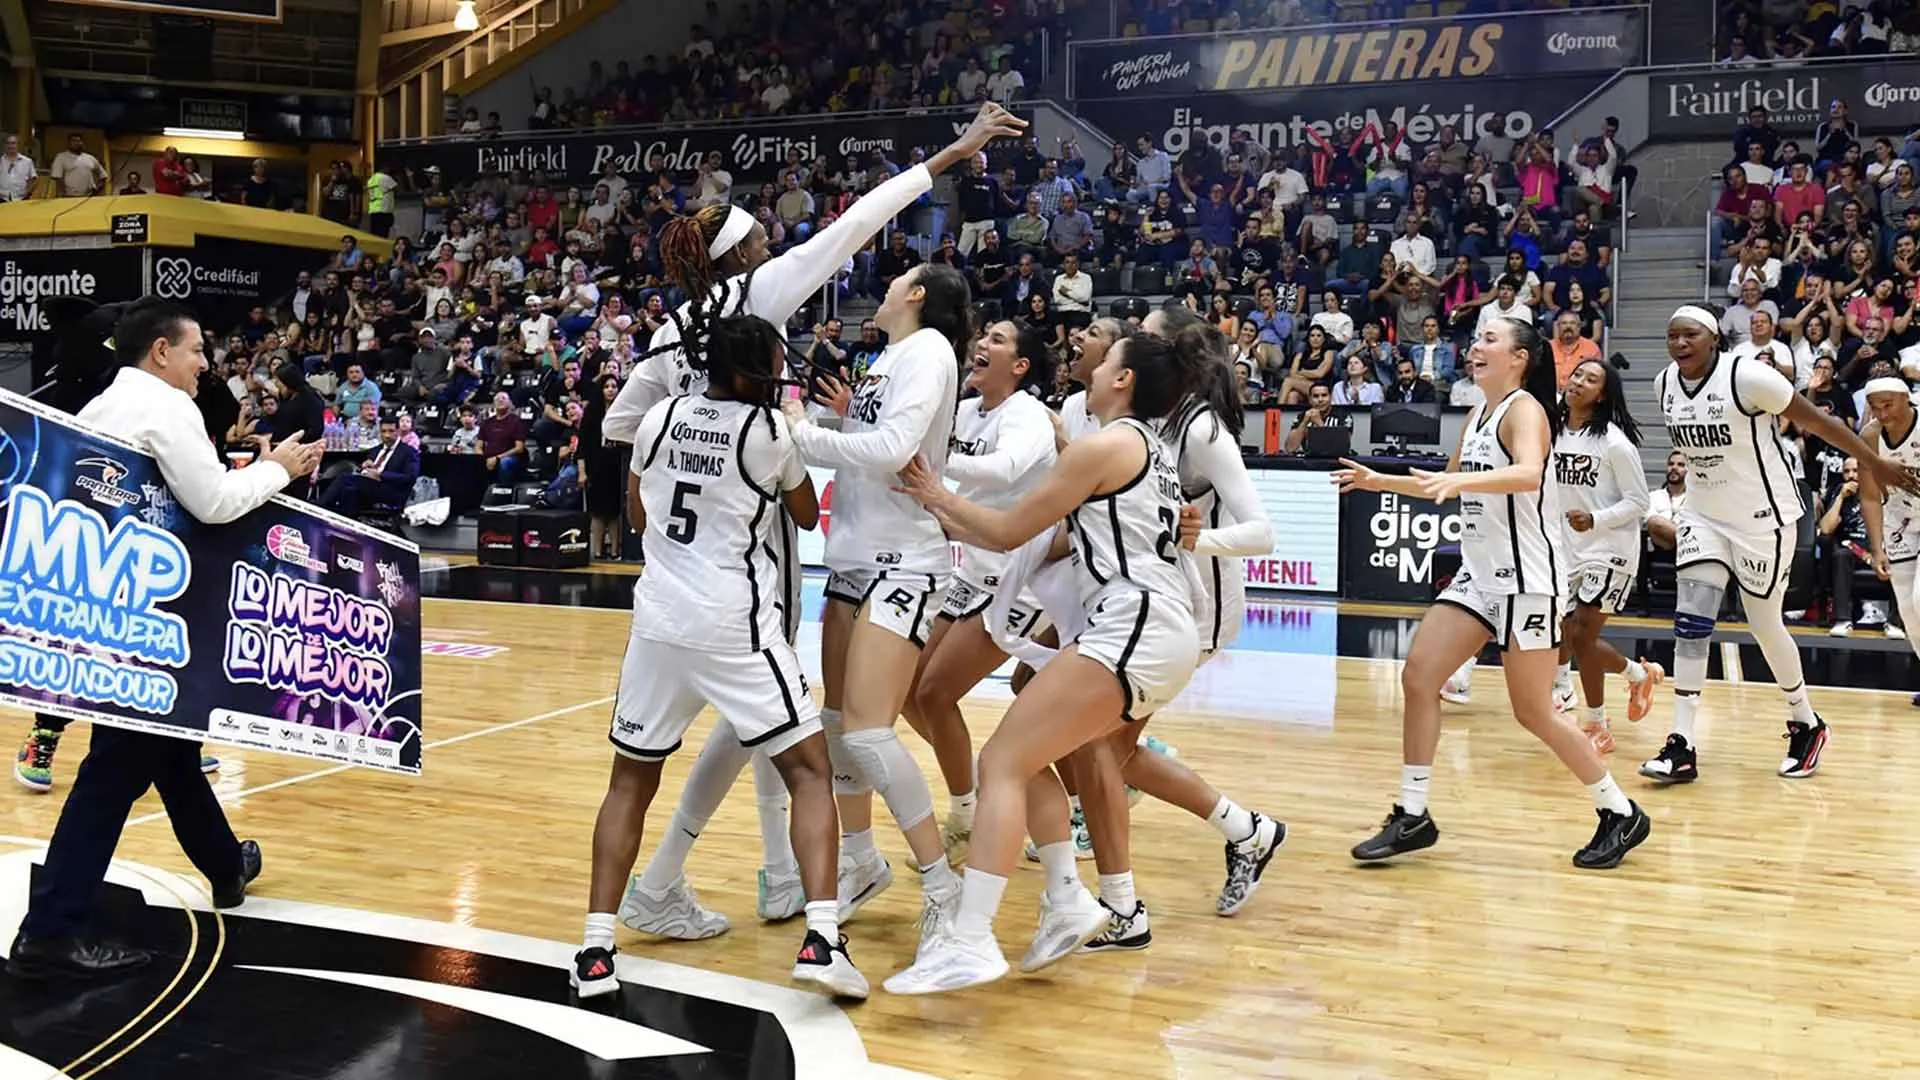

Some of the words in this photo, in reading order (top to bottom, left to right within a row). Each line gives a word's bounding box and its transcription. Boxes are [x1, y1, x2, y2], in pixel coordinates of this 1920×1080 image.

[1214, 23, 1503, 91] PANTERAS
[1547, 31, 1618, 55] Corona
[1111, 52, 1172, 76] PANTERA
[1116, 74, 1140, 91] QUE
[1668, 77, 1820, 117] Fairfield
[1174, 108, 1190, 125] El
[1335, 112, 1364, 130] de
[1365, 104, 1533, 143] México
[478, 144, 568, 173] Fairfield
[590, 140, 641, 175] Red
[758, 135, 817, 163] Fitsi
[5, 261, 16, 275] El
[194, 266, 259, 286] Credifácil
[0, 269, 96, 303] gigante
[0, 305, 16, 319] de
[670, 420, 732, 445] Corona
[667, 449, 677, 470] A.
[680, 451, 724, 477] THOMAS
[76, 477, 139, 502] PANTERAS
[1380, 493, 1398, 512] El
[666, 480, 702, 545] 5
[1156, 506, 1182, 565] 2
[3, 492, 188, 608] MVP
[1369, 550, 1398, 567] de
[1244, 558, 1318, 586] MENIL
[0, 580, 182, 656] EXTRANJERA
[233, 566, 267, 618] LO
[272, 577, 389, 653] MEJOR
[228, 624, 263, 677] LO
[270, 634, 389, 706] MEJOR
[74, 658, 172, 711] NDOUR
